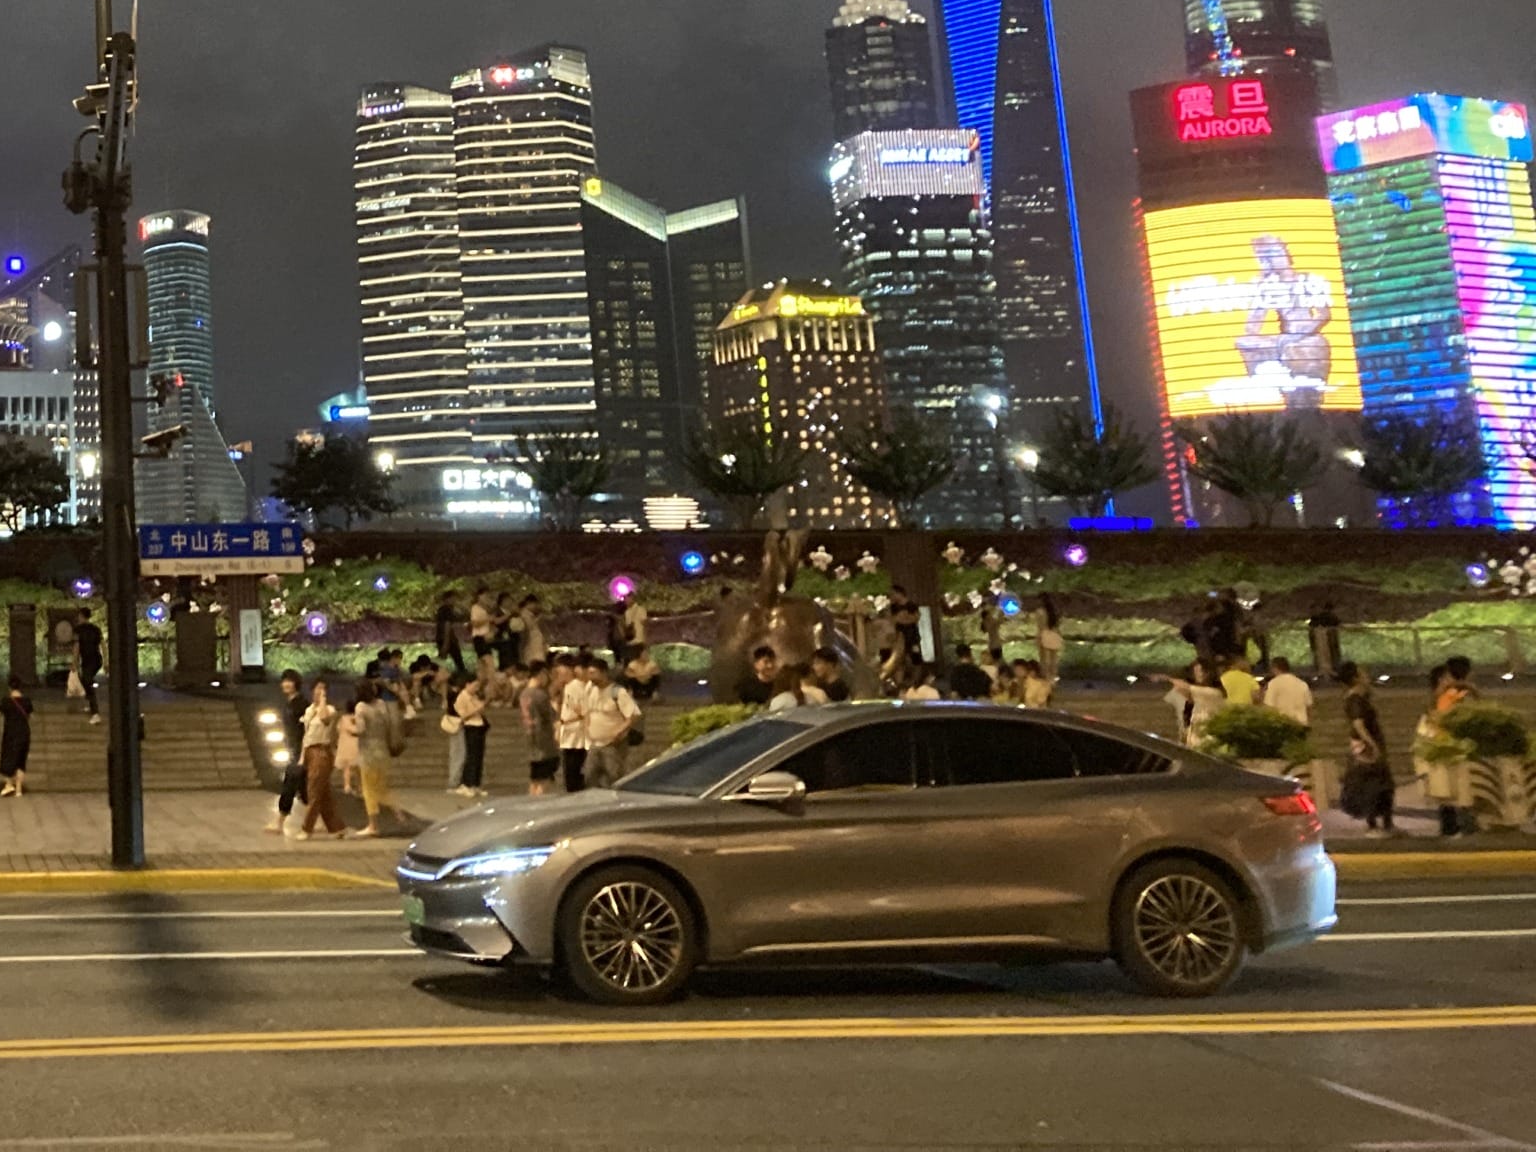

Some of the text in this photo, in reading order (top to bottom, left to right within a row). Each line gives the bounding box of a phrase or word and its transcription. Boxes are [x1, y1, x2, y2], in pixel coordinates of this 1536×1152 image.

[1177, 81, 1269, 121] 震旦
[1182, 116, 1272, 140] AURORA
[170, 529, 270, 552] 中山东一路
